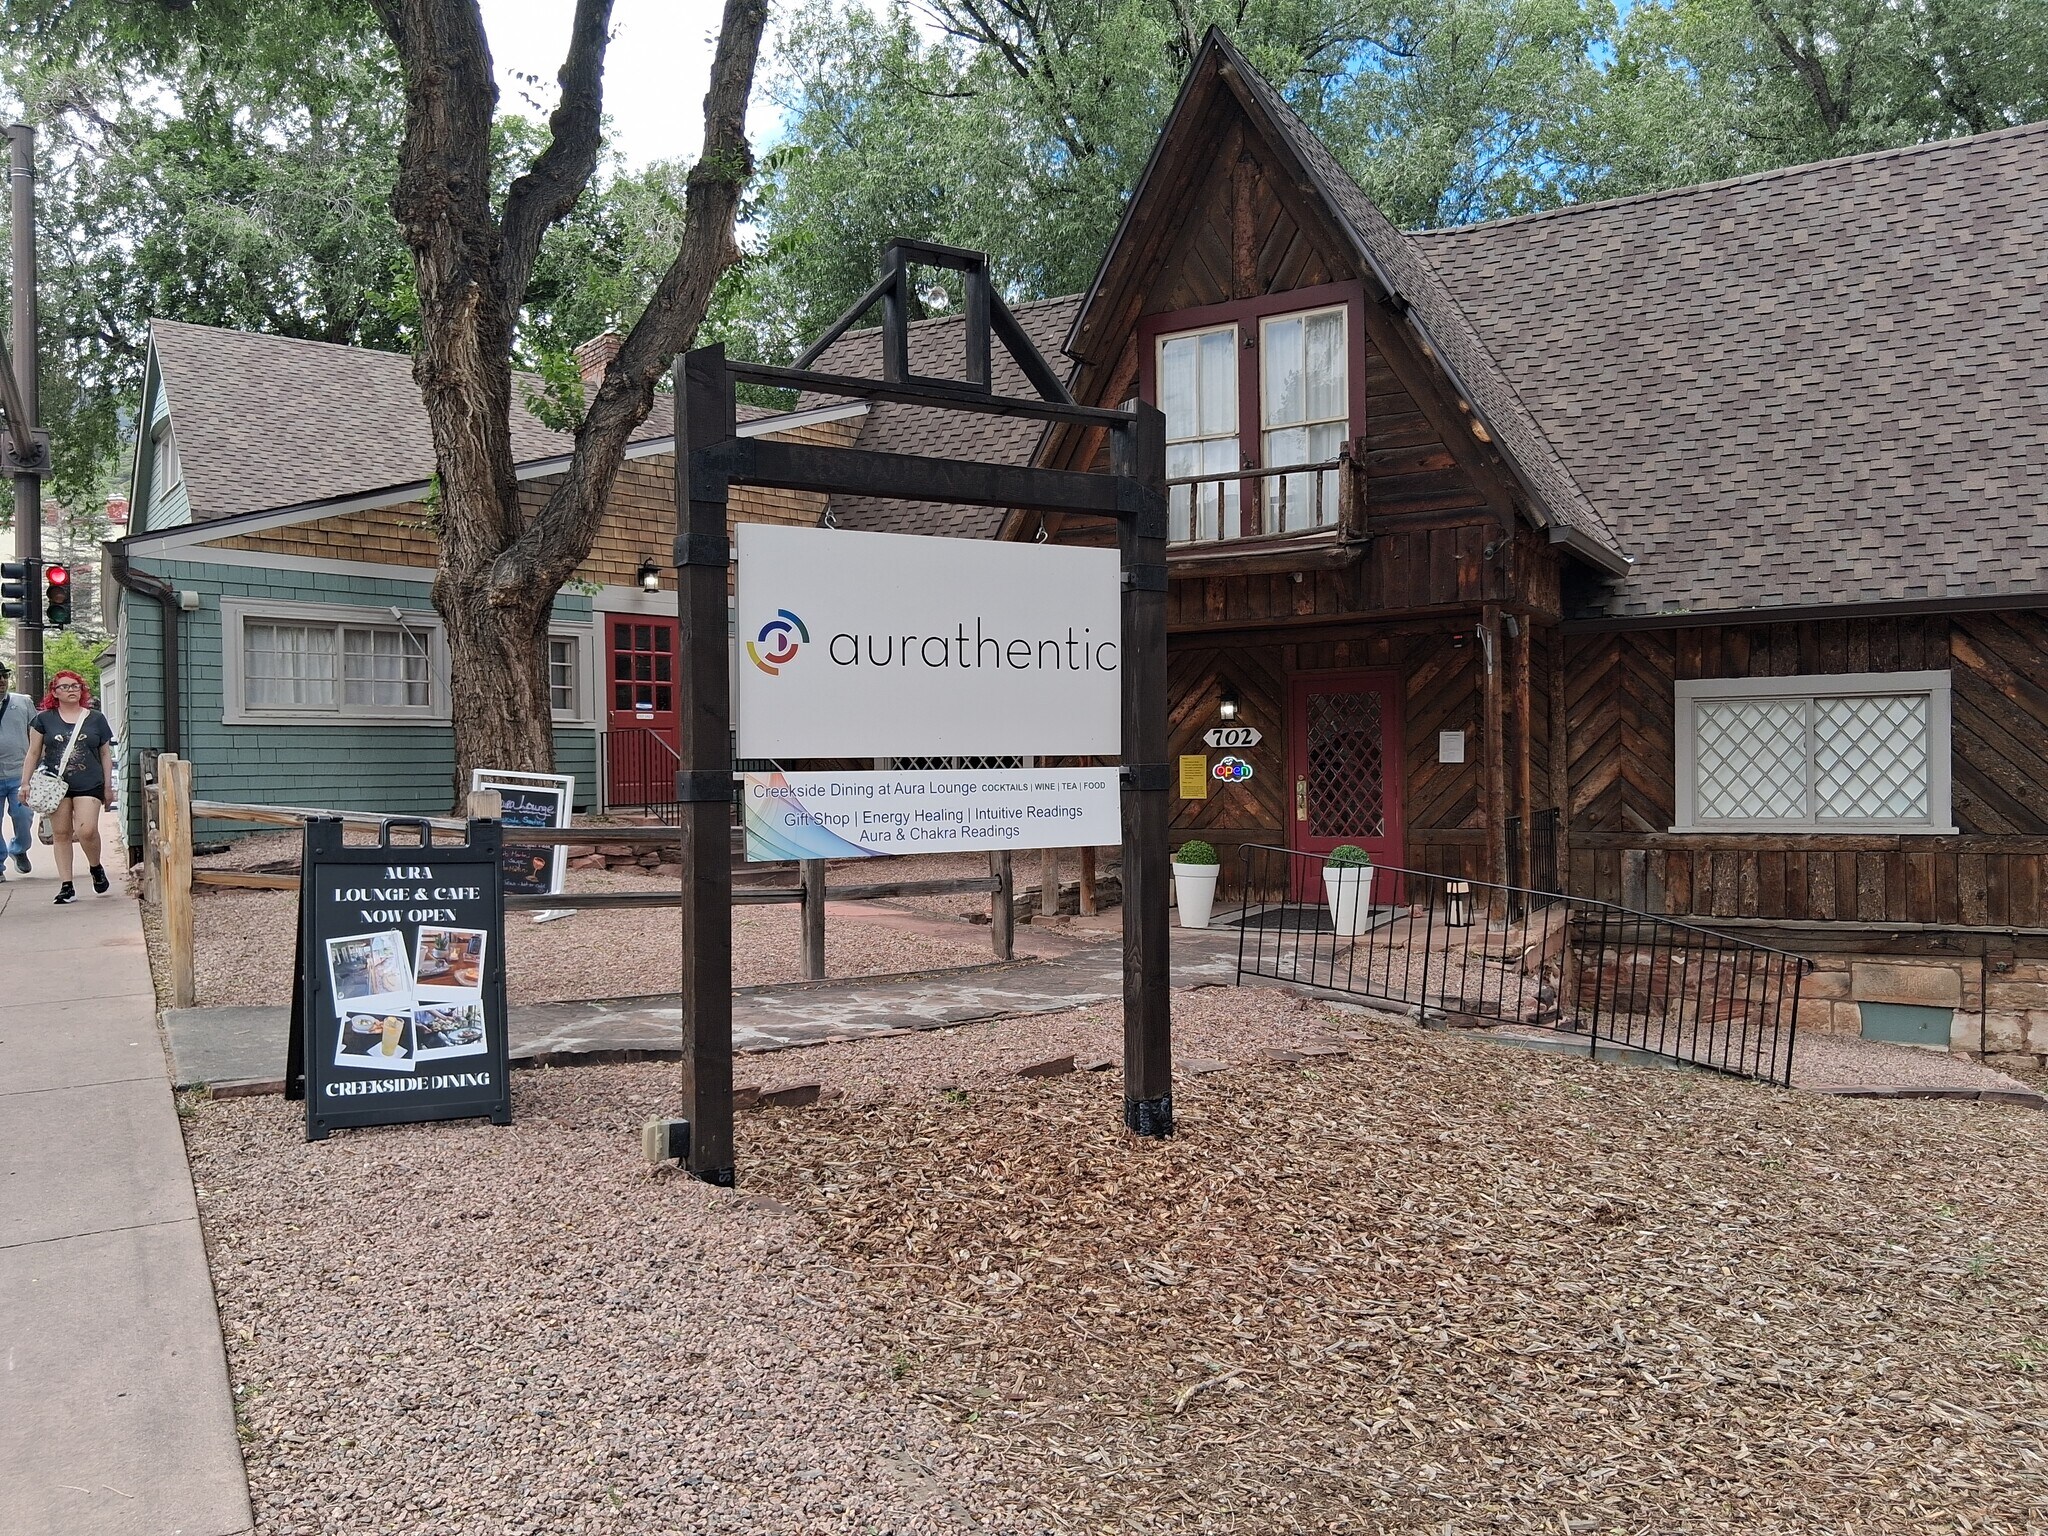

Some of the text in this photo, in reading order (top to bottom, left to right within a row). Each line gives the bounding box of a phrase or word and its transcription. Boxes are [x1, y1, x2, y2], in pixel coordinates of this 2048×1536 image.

[829, 616, 1118, 671] aurathentic
[1212, 728, 1253, 746] 702
[1216, 766, 1249, 778] open
[753, 783, 826, 799] Creekside
[831, 782, 874, 799] Dining
[878, 784, 891, 795] at
[894, 782, 925, 795] Aura
[929, 781, 977, 796] Lounge
[981, 783, 1028, 792] COCKTAILS
[1034, 782, 1056, 791] WINE
[1061, 782, 1078, 790] TEA
[1083, 781, 1106, 790] FOOD
[784, 812, 809, 827] Gift
[813, 812, 850, 827] Shop
[863, 810, 910, 825] Energy
[914, 809, 963, 823] Healing
[975, 806, 1023, 820] Intuitive
[1027, 805, 1083, 820] Readings
[859, 825, 1020, 842] Aura & Chakra Readings
[384, 866, 433, 880] AURA
[334, 887, 480, 902] LOUNGE & CAFE
[360, 908, 457, 923] NOW OPEN
[325, 1071, 490, 1097] CREEKSIDE DINING
